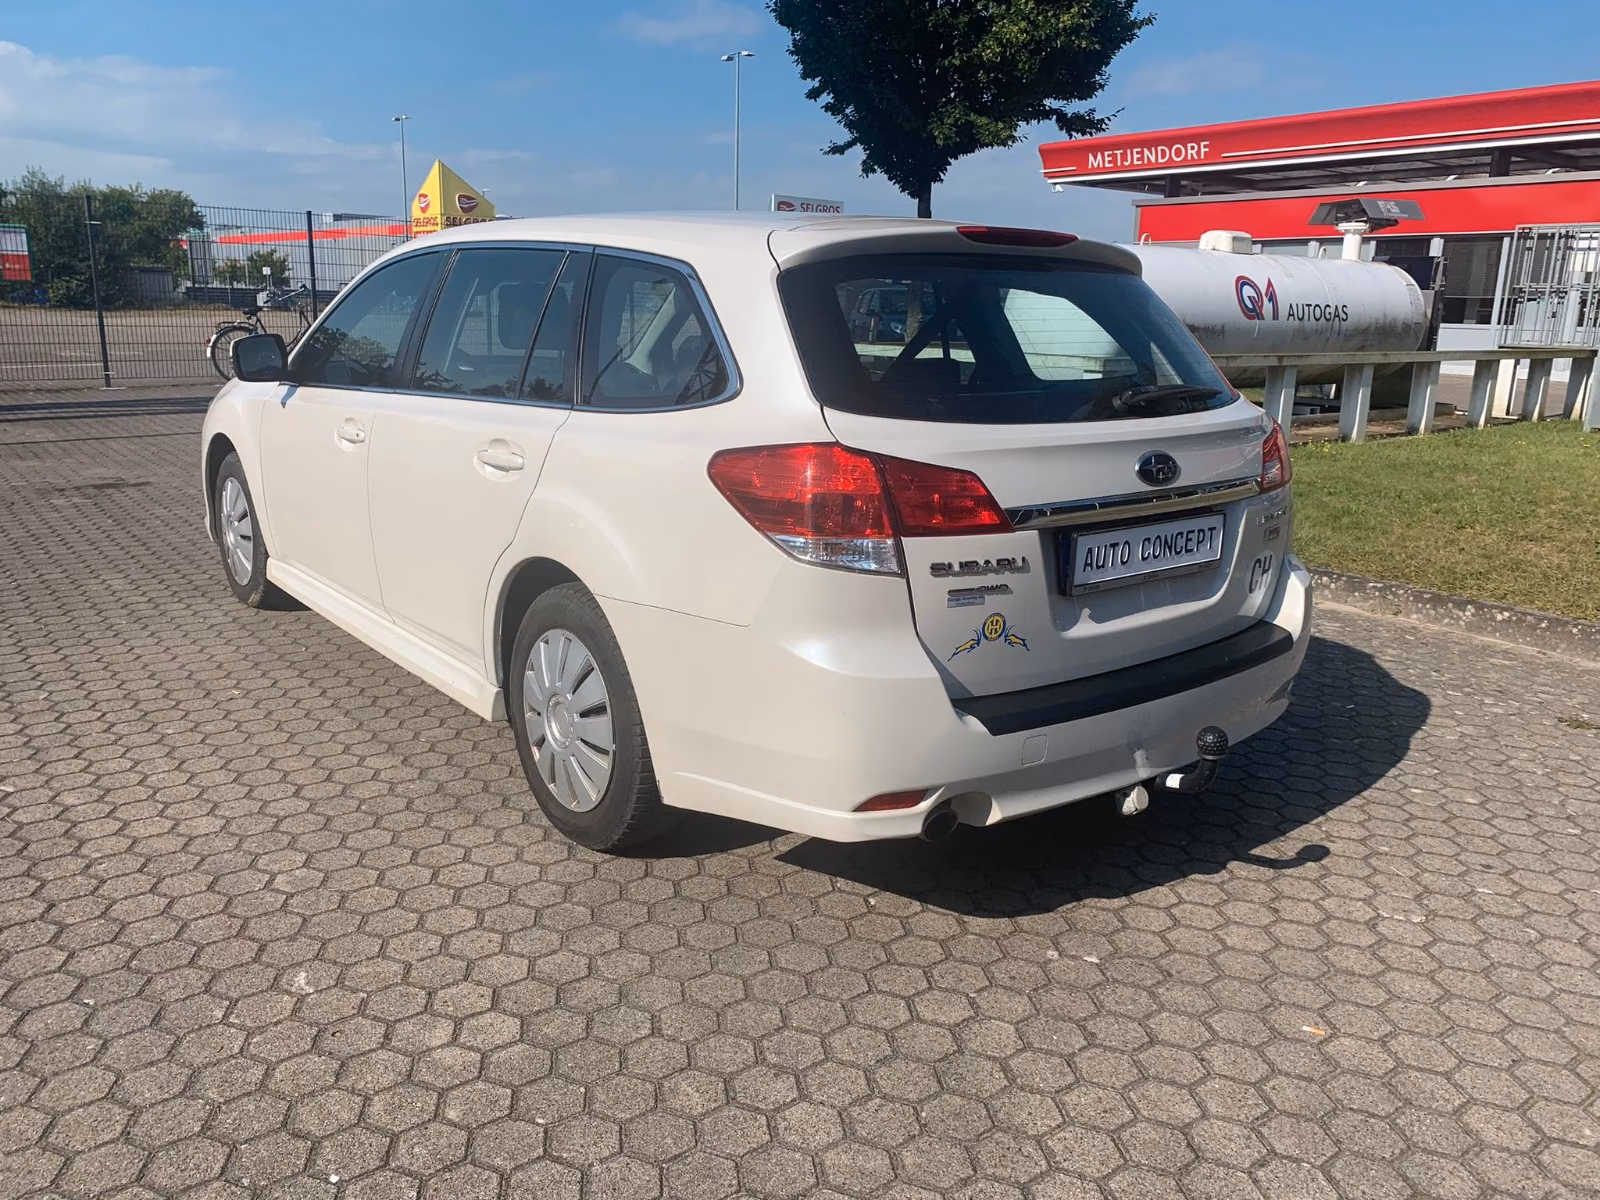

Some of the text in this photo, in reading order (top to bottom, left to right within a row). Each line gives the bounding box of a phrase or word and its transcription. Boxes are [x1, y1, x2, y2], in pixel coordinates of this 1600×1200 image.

[1088, 141, 1210, 169] METJENDORF
[1234, 275, 1279, 321] Q1
[1286, 303, 1349, 322] AUTOGAS
[1083, 526, 1217, 572] AUTO CONCEPT
[929, 556, 1031, 578] SUBARU
[1249, 554, 1273, 594] CH
